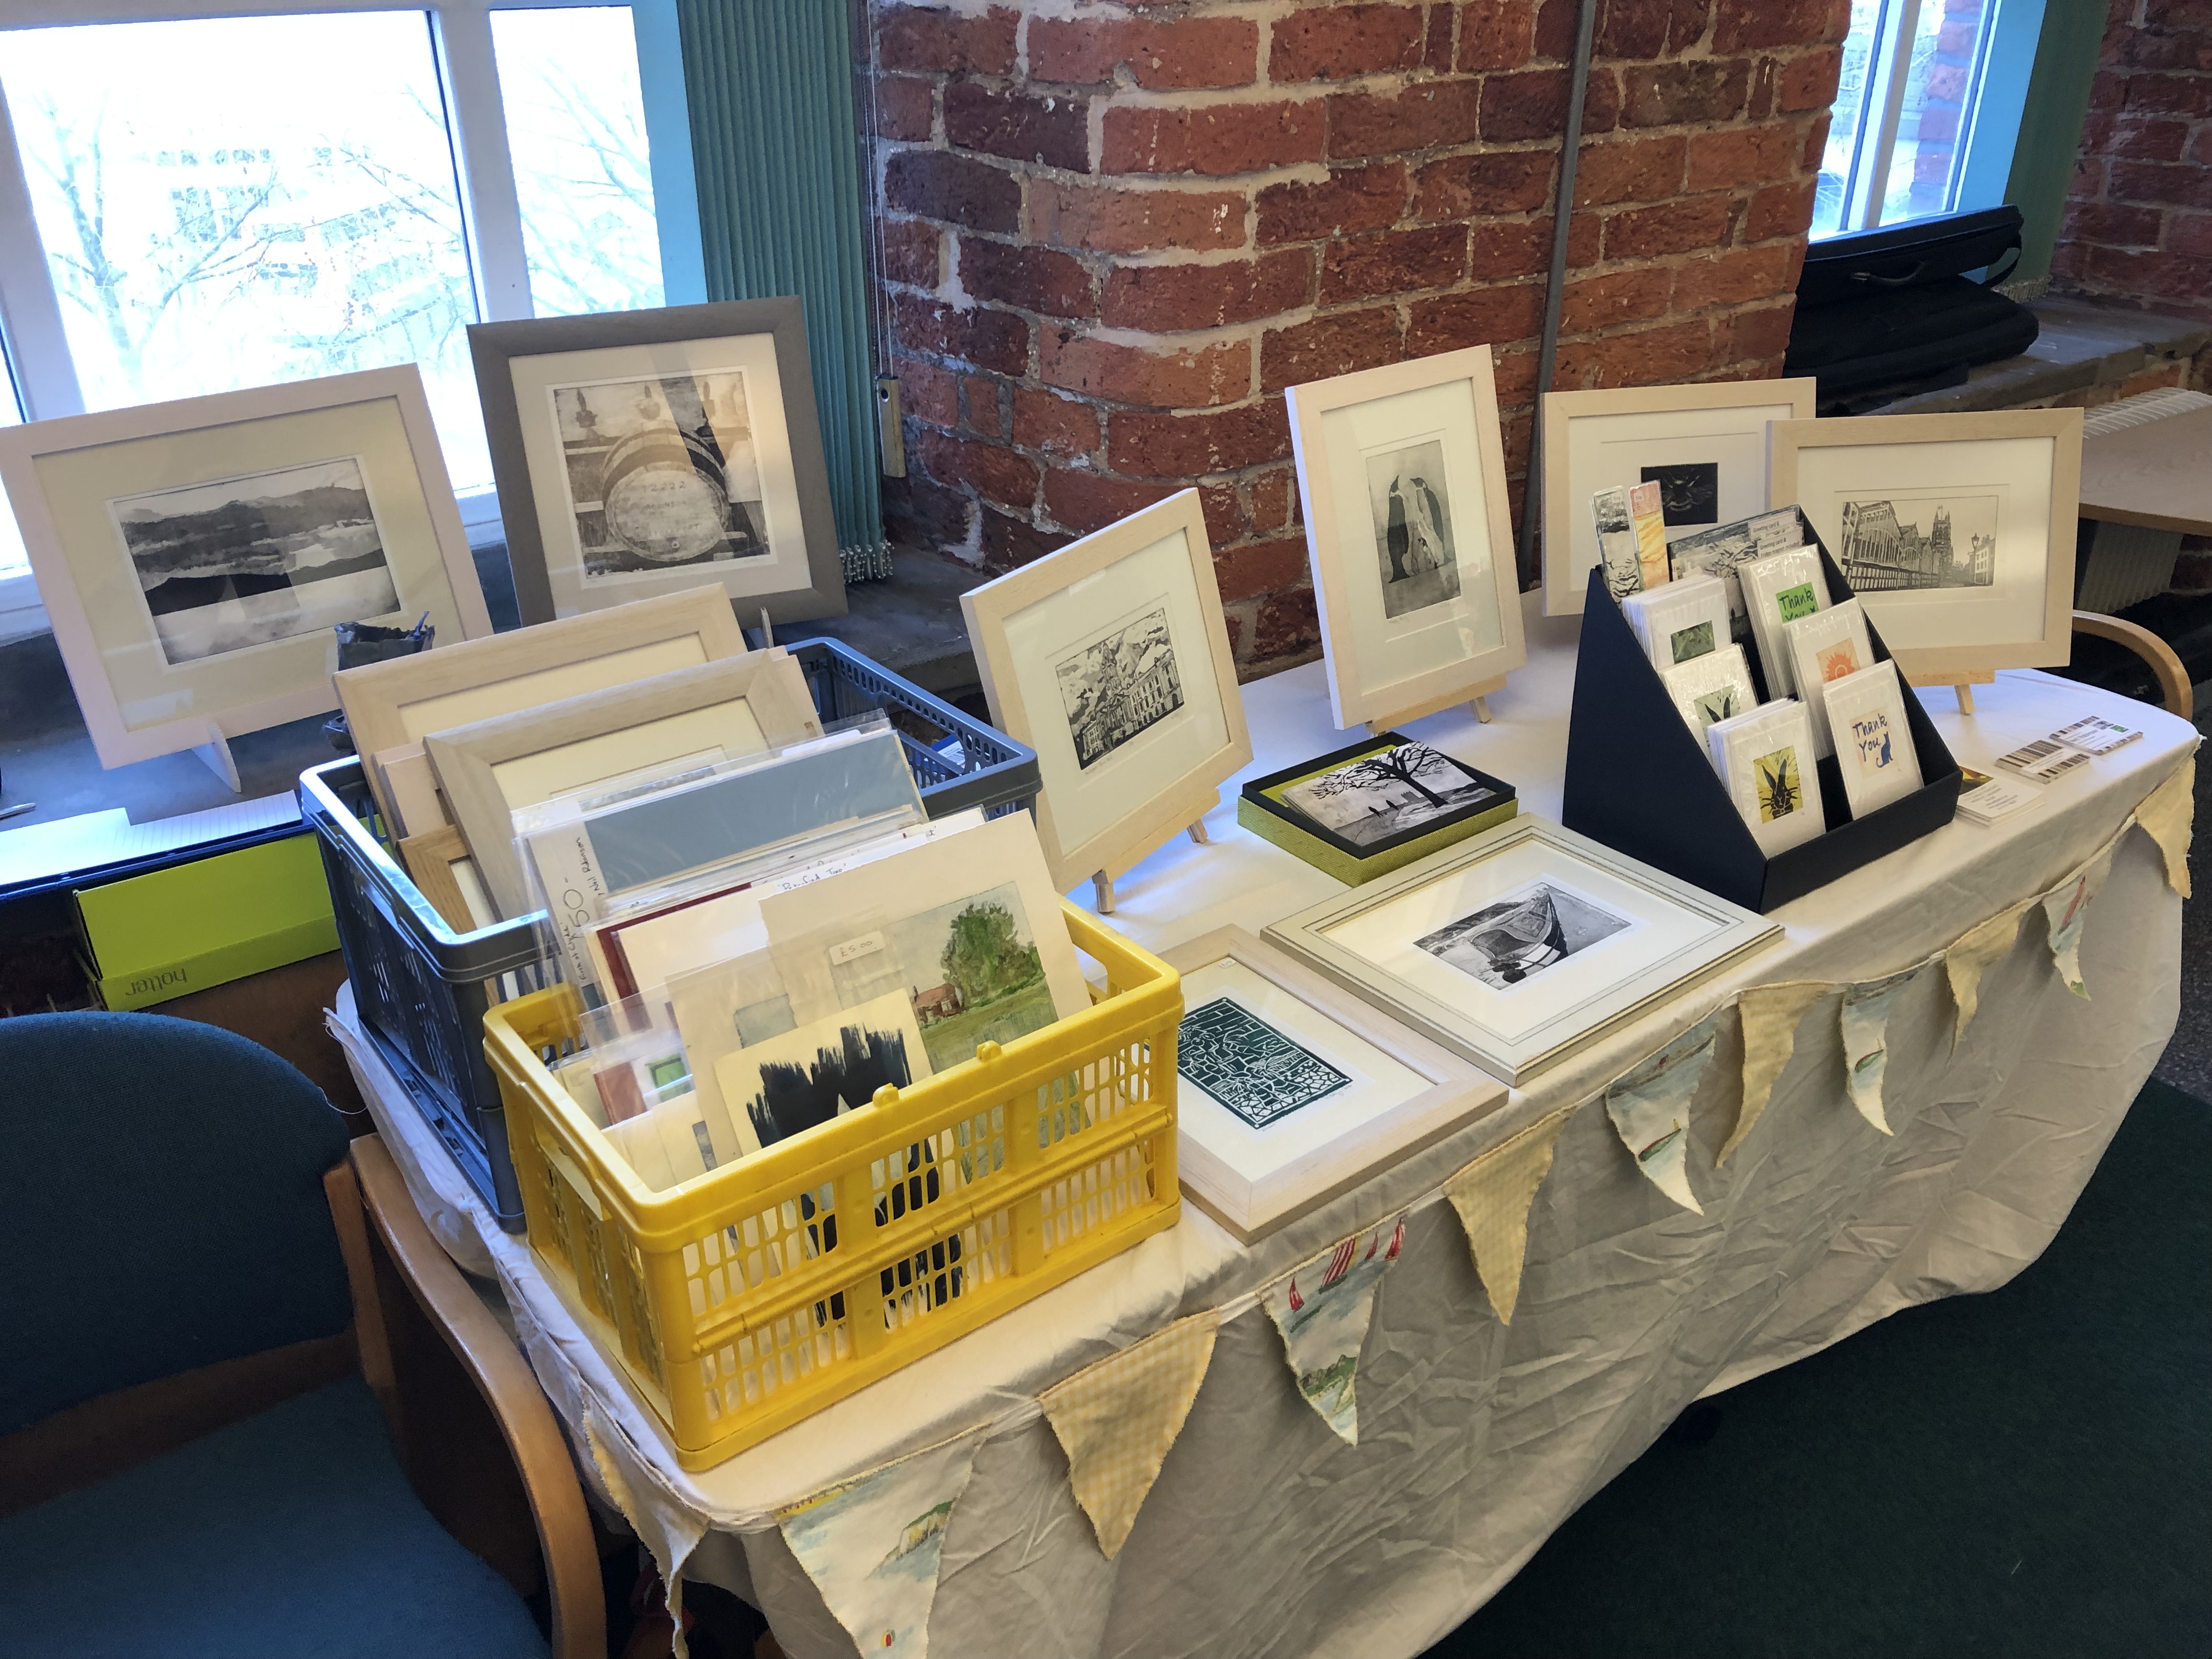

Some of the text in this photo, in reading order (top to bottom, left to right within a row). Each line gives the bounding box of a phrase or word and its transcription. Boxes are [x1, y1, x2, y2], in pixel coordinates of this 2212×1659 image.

[1753, 525, 1769, 533] Greeting
[1760, 541, 1775, 550] Greeting
[1779, 588, 1814, 611] Thank
[1852, 713, 1888, 739] Thank
[1859, 737, 1881, 763] You
